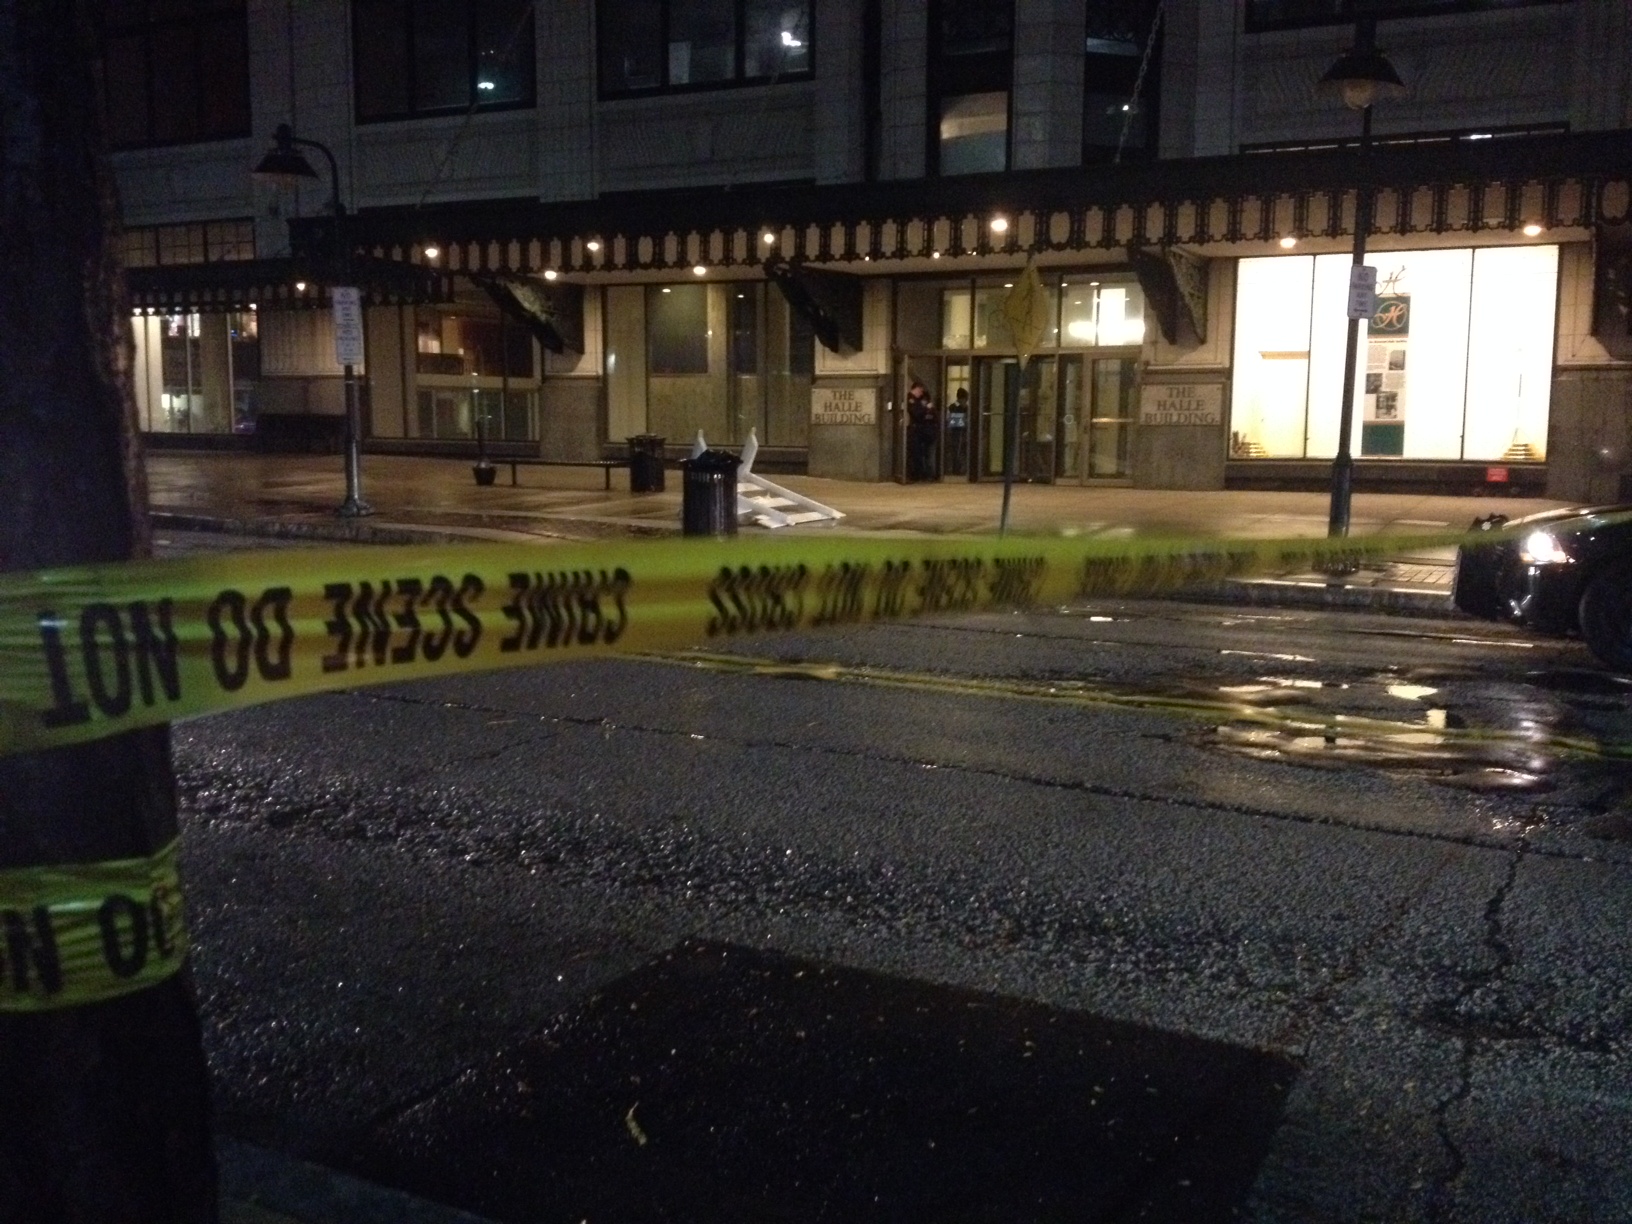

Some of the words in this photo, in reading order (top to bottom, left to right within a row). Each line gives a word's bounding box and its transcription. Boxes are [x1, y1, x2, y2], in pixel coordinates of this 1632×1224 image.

[831, 390, 855, 401] THE
[1165, 386, 1196, 399] THE
[823, 401, 863, 413] HALLE
[1156, 399, 1206, 412] HALLE
[814, 413, 872, 425] BUILDING
[1143, 412, 1216, 425] BUILDING
[501, 567, 632, 653] CRIME
[321, 573, 487, 675] SCENE
[207, 586, 294, 692] DO
[38, 597, 182, 729] NOT
